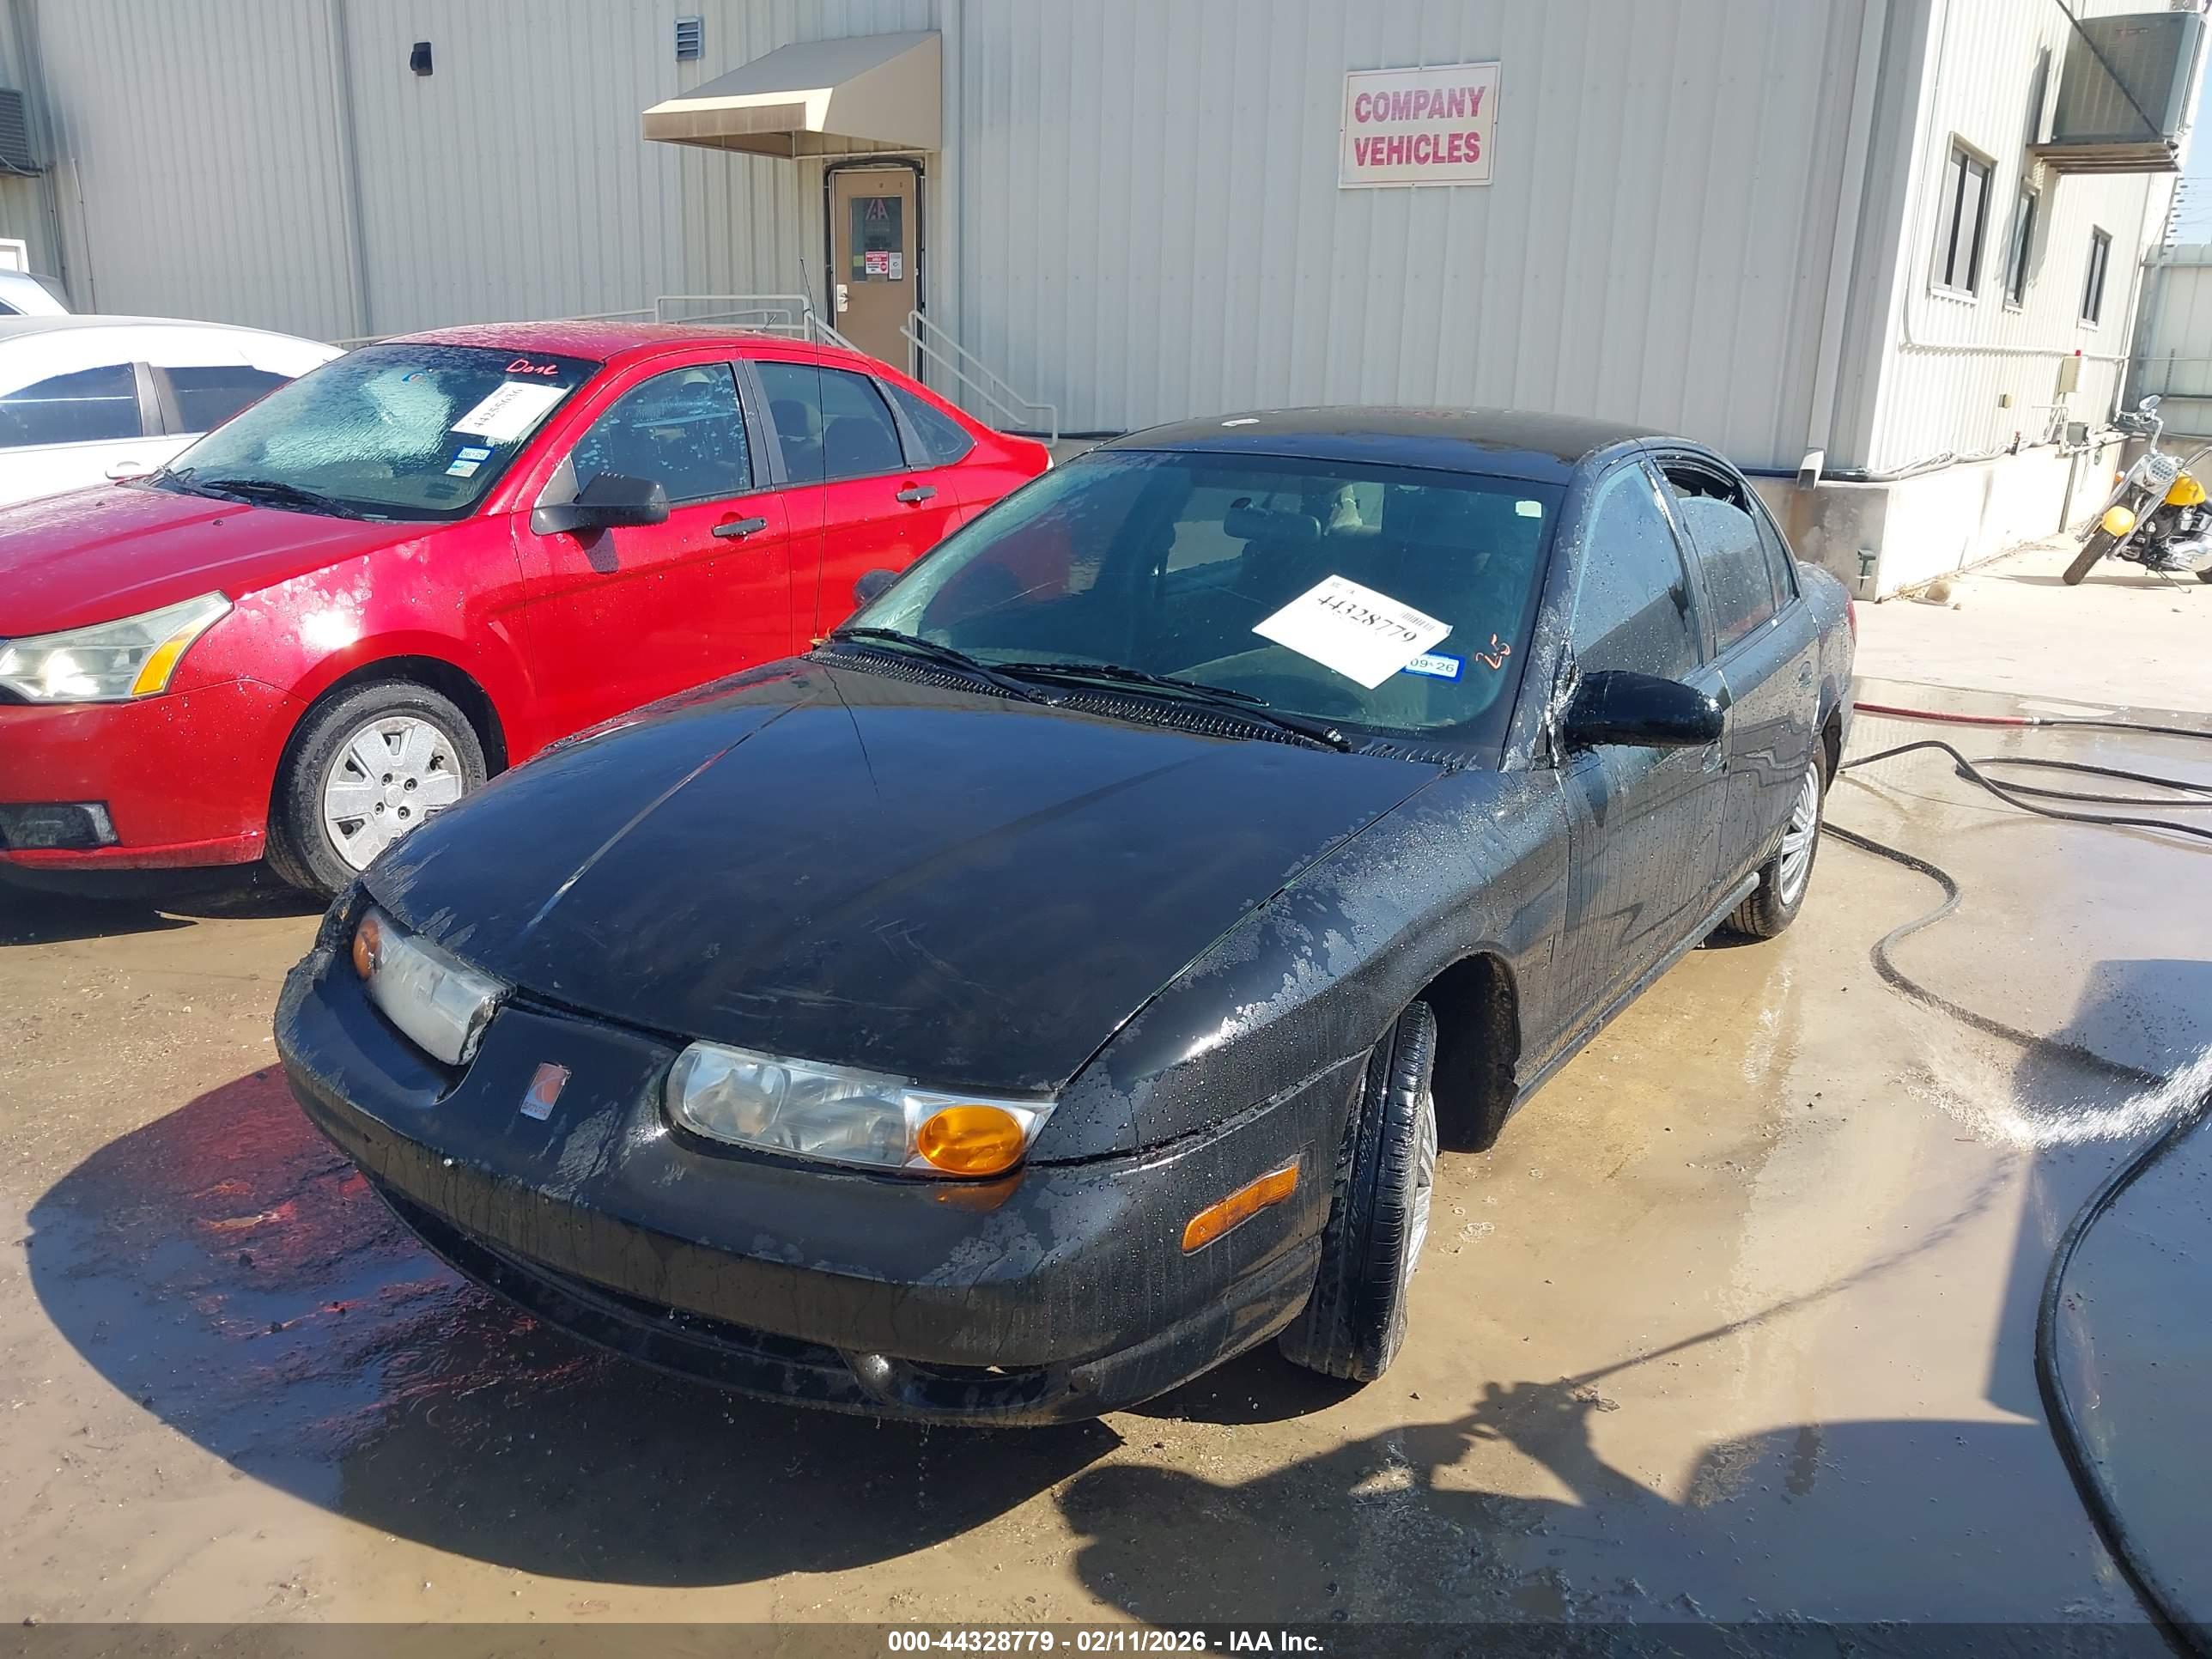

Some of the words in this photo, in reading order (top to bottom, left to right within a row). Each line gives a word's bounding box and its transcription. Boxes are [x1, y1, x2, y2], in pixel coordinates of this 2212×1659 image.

[1354, 86, 1486, 123] COMPANY
[1354, 131, 1481, 166] VEHICLES
[1317, 595, 1417, 642] 44328779
